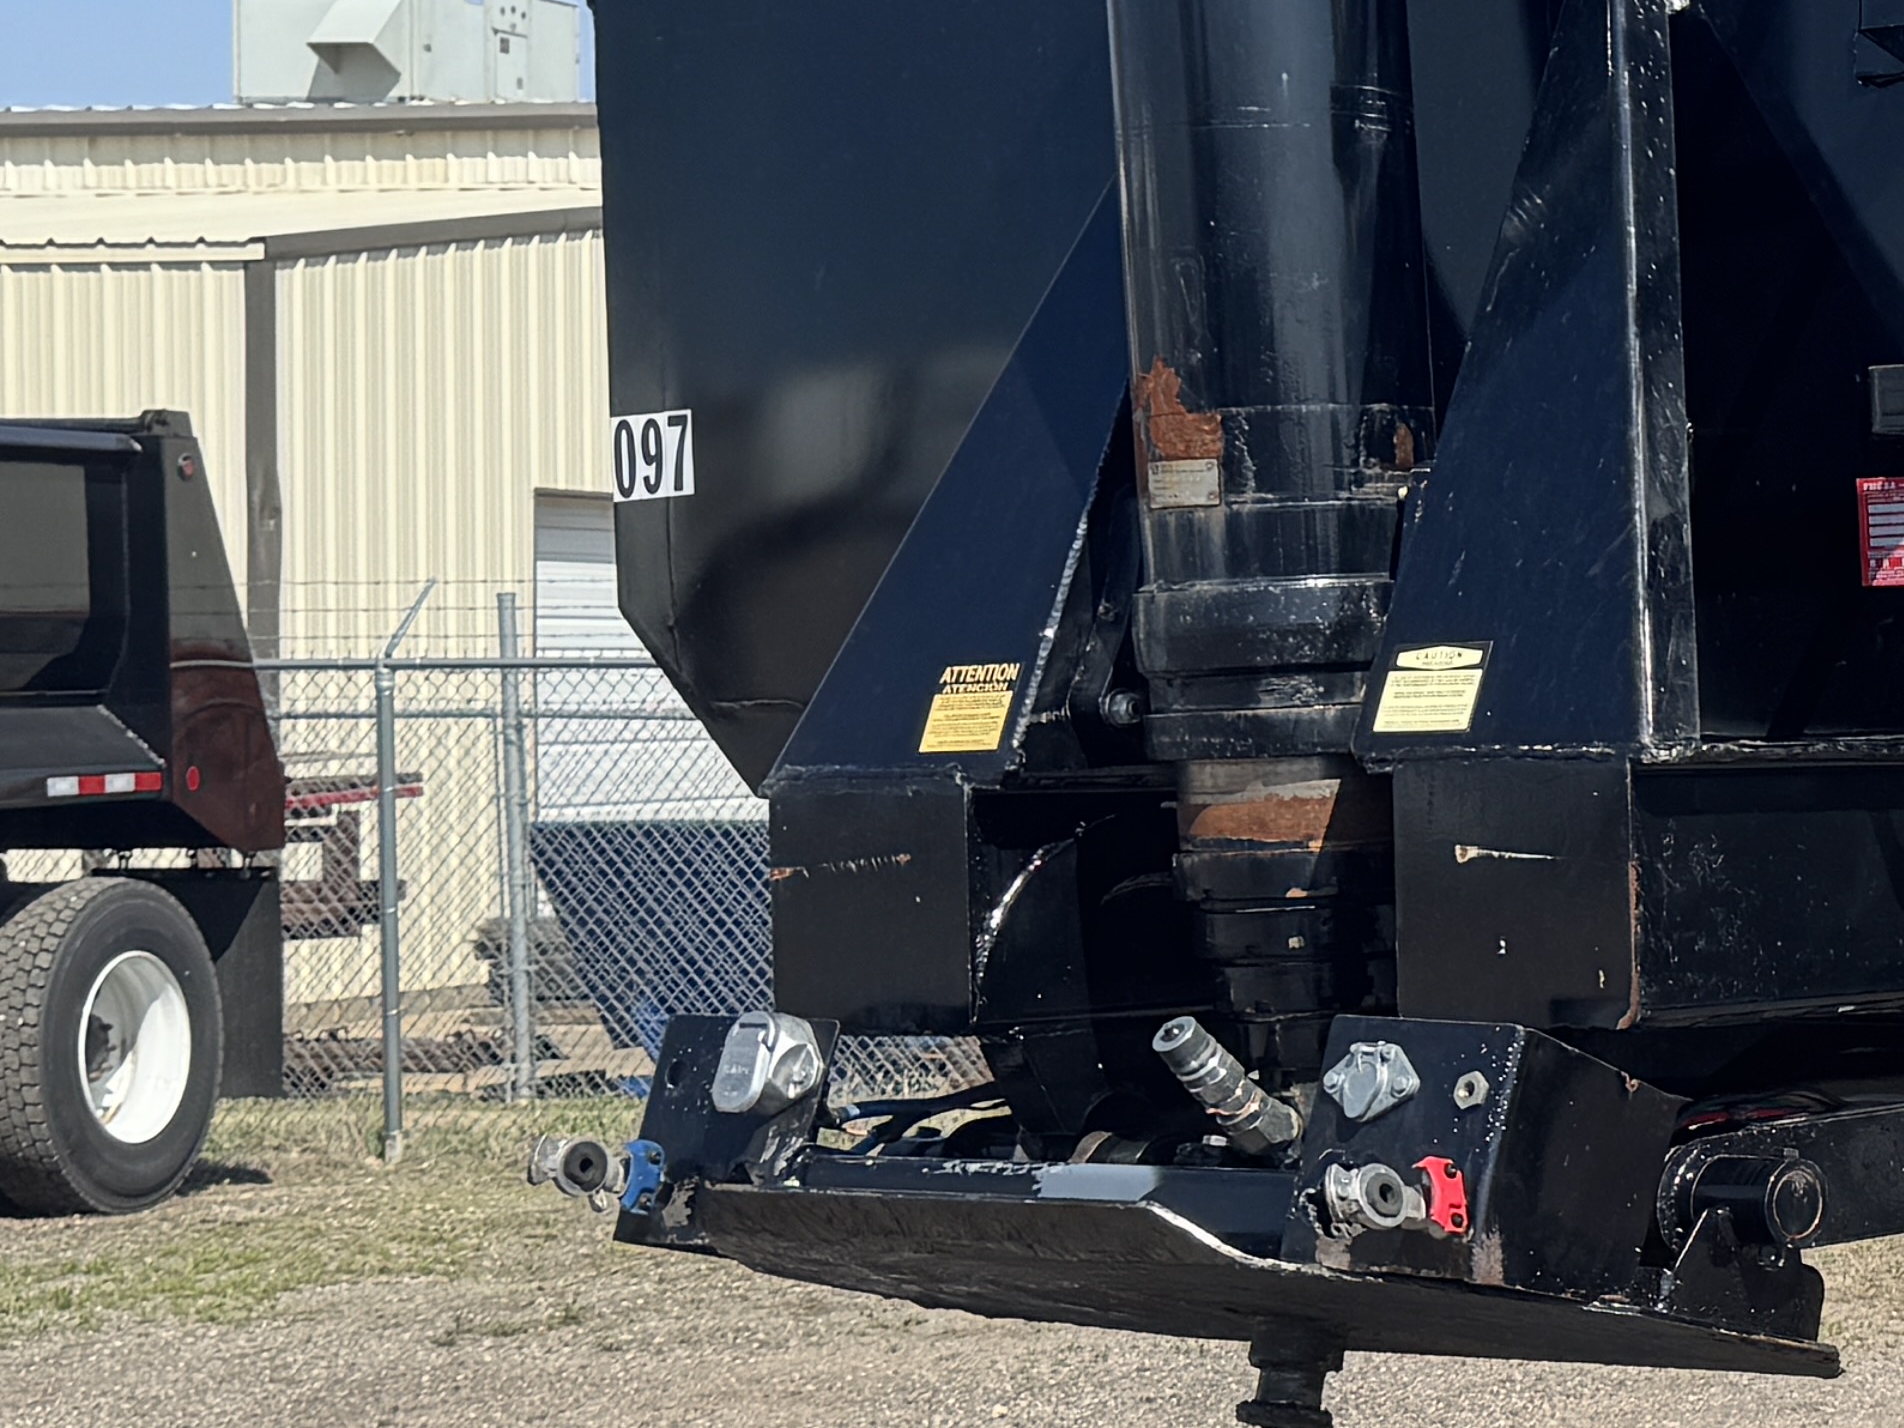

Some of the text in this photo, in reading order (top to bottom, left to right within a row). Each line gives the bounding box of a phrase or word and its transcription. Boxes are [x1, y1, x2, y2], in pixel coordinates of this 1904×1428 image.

[614, 414, 688, 499] 097
[1416, 650, 1462, 660] CAUTION
[939, 662, 1020, 684] ATTENTION
